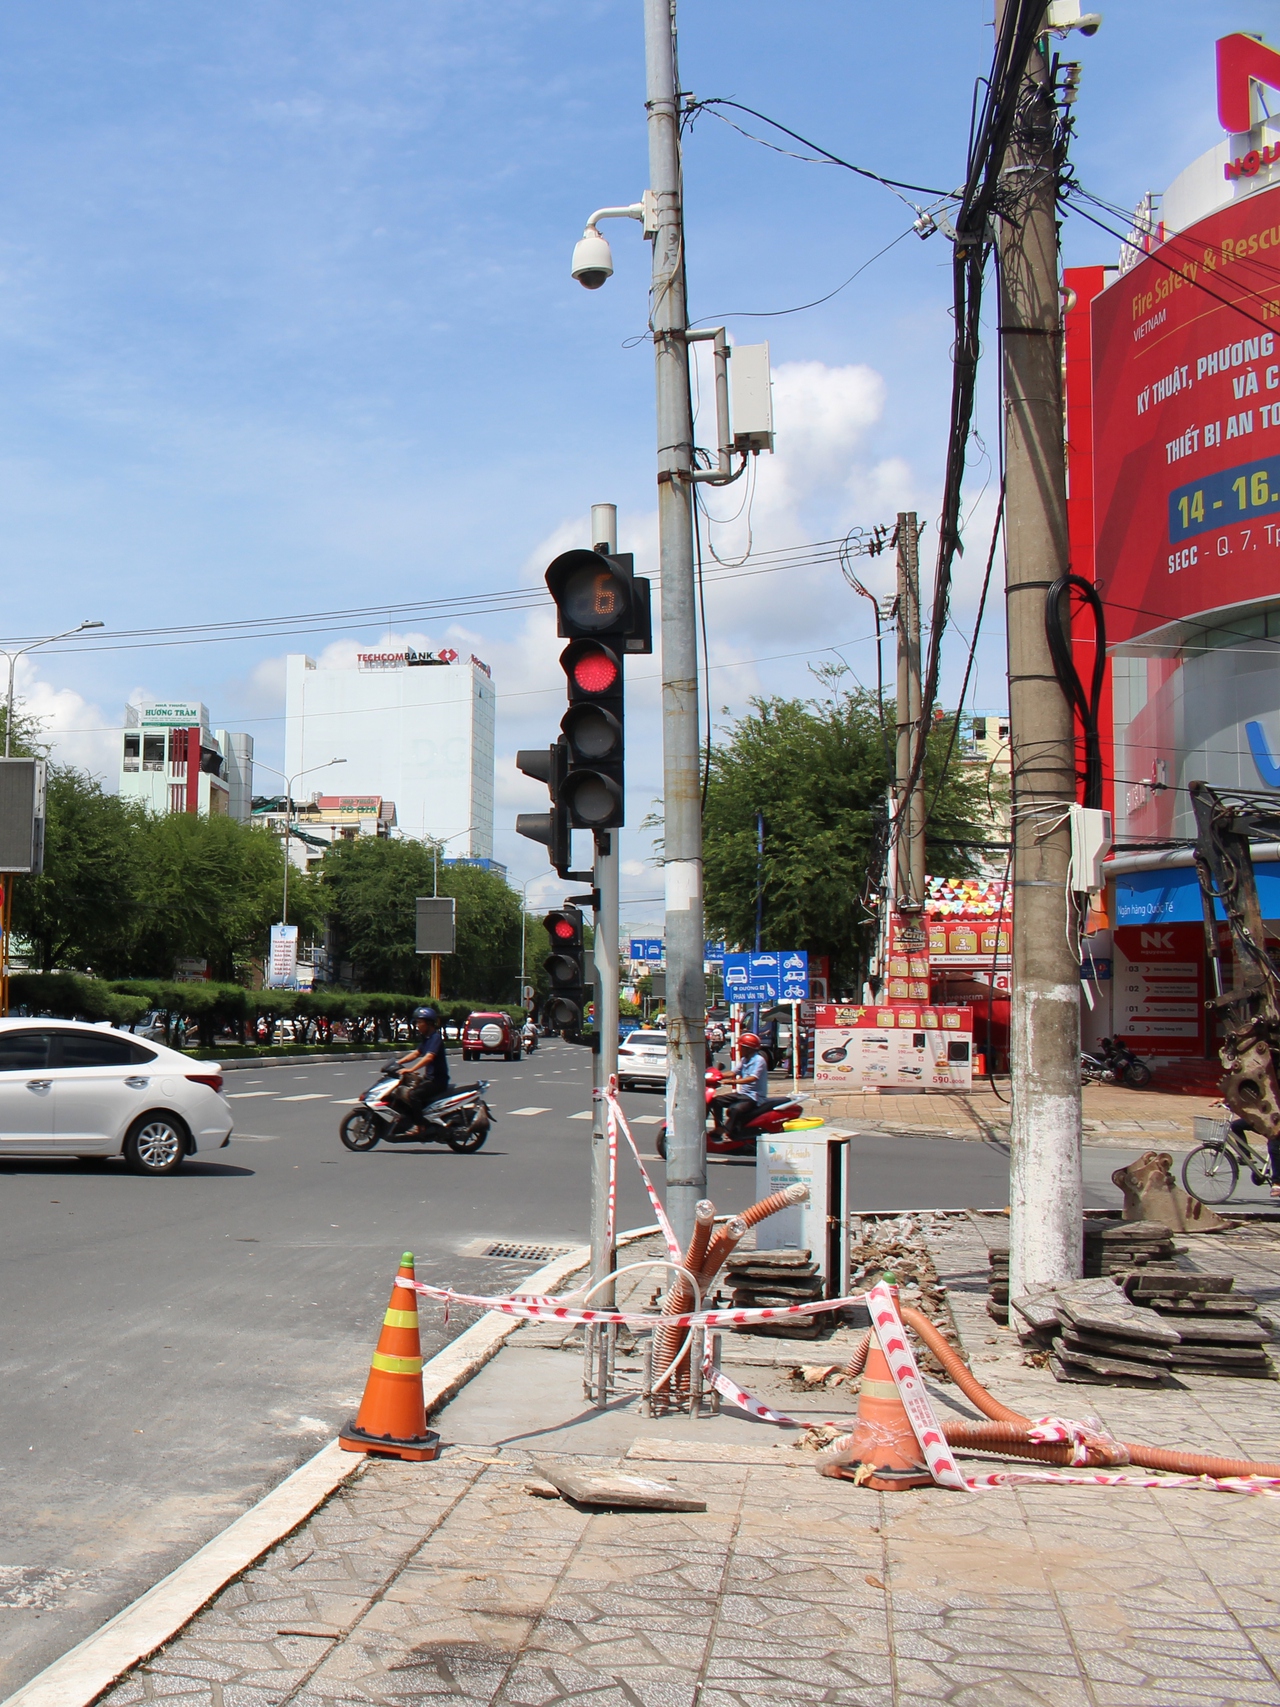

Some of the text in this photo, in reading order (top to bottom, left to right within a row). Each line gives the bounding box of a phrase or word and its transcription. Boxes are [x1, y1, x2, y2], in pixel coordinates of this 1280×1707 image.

[1132, 292, 1153, 321] Fire
[1155, 259, 1198, 304] Safety
[1203, 247, 1216, 274] &
[1133, 308, 1167, 342] VIETNAM
[1136, 333, 1274, 416] KỸ THUẬT, PHƯƠNG
[1232, 366, 1259, 400] VÀ
[1166, 424, 1200, 465] THIẾT
[1204, 421, 1221, 448] BỊ
[1226, 409, 1253, 440] AN
[1178, 470, 1279, 529] 14 - 16.
[1168, 545, 1198, 575] SECC
[1217, 536, 1233, 557] Q.
[1240, 530, 1257, 551] 7,
[593, 574, 615, 614] 6
[357, 651, 433, 662] TECHCOMBANK
[146, 708, 173, 716] HƯƠNG
[1117, 900, 1174, 917] Ngân hàng Quốc Tế
[960, 938, 966, 946] 3
[1141, 932, 1175, 948] NK
[747, 992, 756, 1000] VĂN
